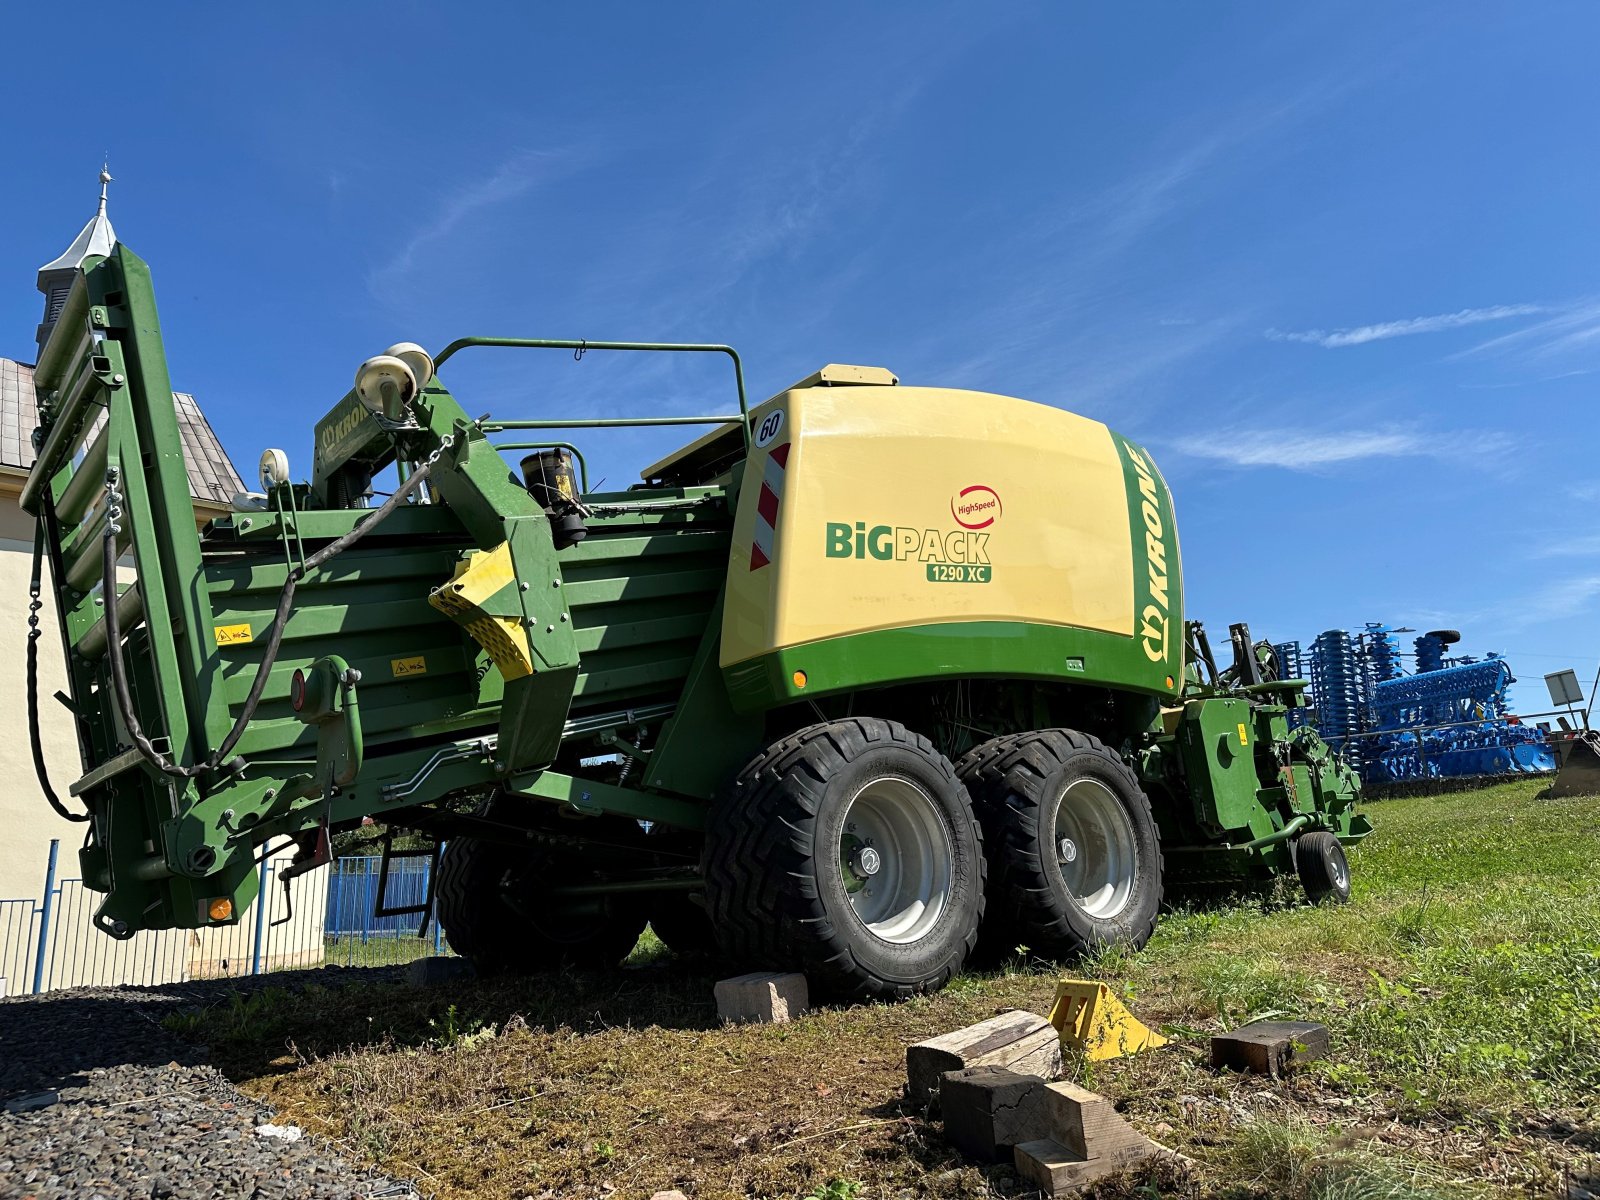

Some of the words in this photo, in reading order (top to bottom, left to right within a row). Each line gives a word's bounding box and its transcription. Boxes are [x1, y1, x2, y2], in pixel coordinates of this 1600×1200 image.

[336, 403, 369, 443] KRON
[760, 413, 780, 442] 60
[958, 499, 996, 515] HighSpeed
[1122, 441, 1169, 611] KRONE
[932, 565, 964, 581] 1290
[967, 566, 985, 582] XC
